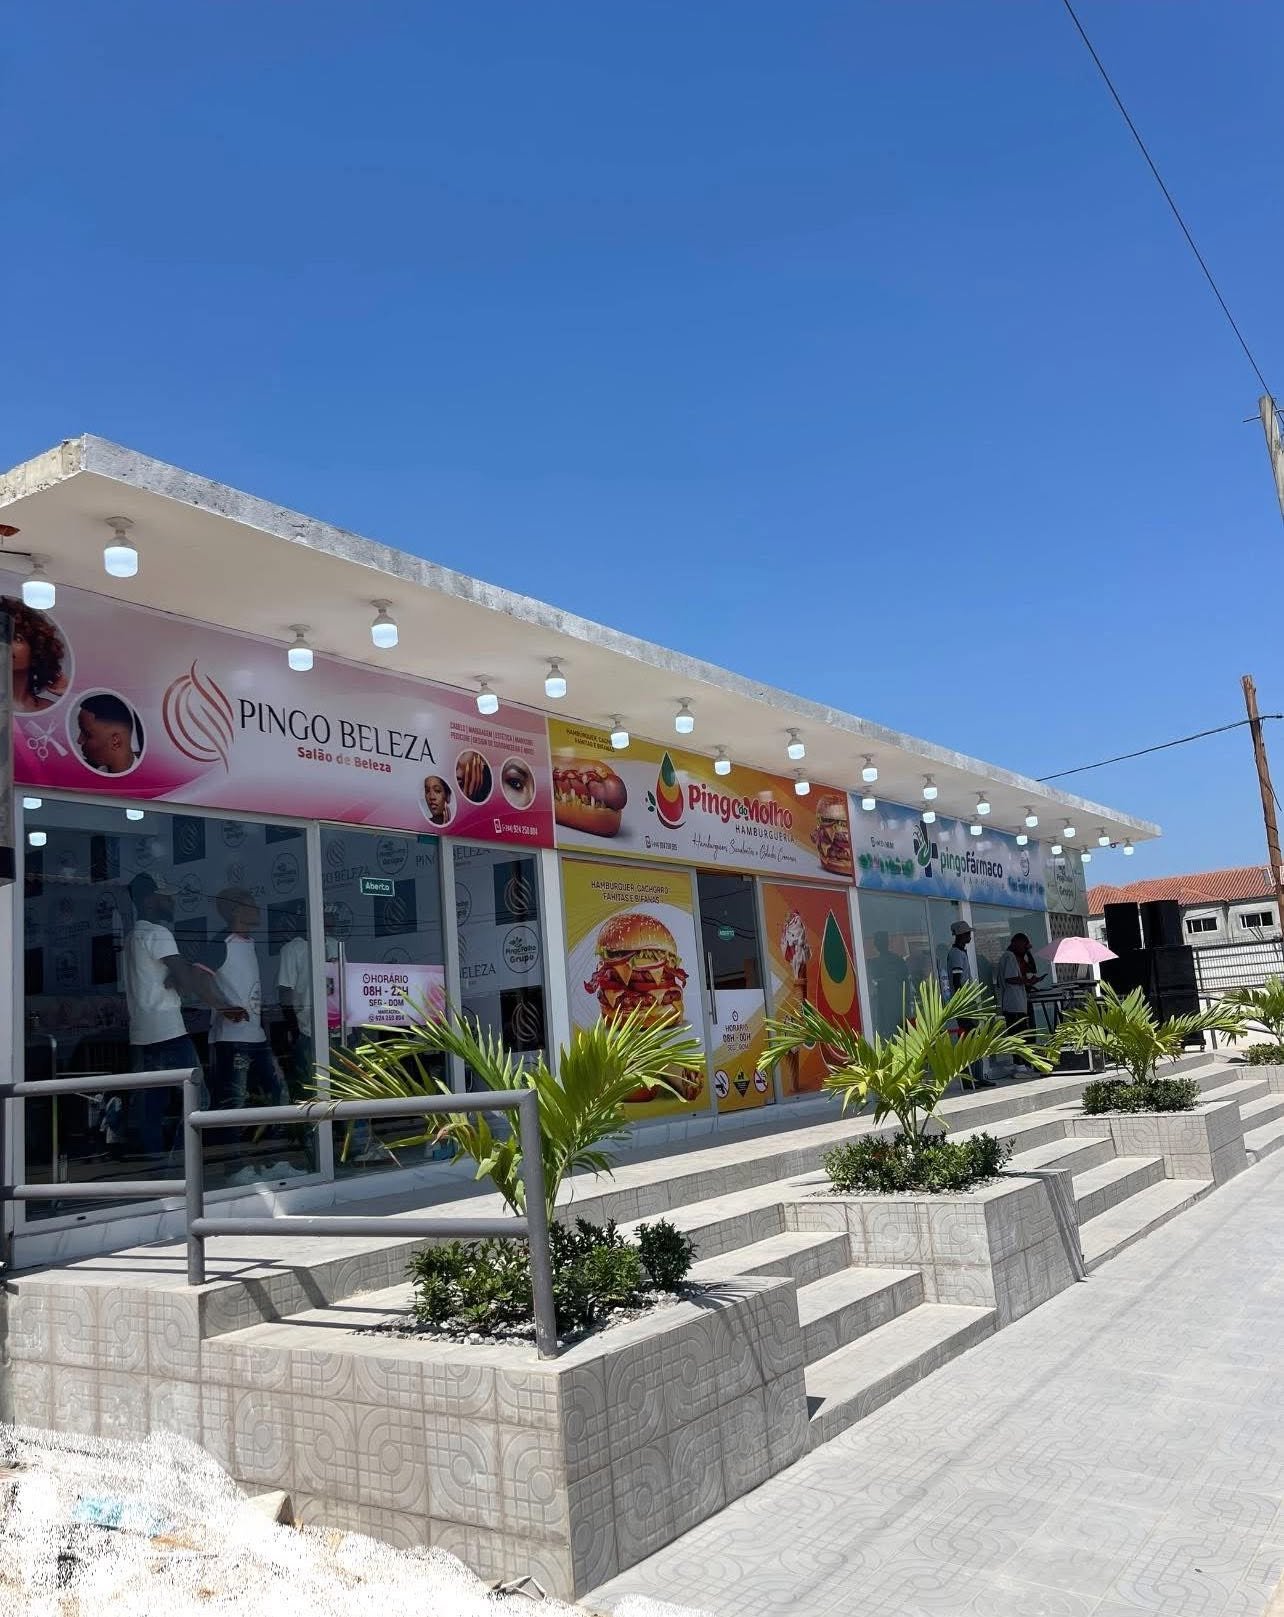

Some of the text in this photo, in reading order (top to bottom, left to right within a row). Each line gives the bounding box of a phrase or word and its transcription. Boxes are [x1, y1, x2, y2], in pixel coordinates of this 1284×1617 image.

[238, 698, 436, 764] PINGO BELEZA
[298, 746, 392, 773] Salão de Beleza
[688, 784, 740, 824] Pingo
[744, 796, 792, 829] Molho
[736, 825, 794, 842] HAMBURGUERIA
[940, 846, 1003, 878] pingofármaco
[366, 880, 390, 891] Aberto
[510, 954, 534, 964] Grupo
[371, 973, 408, 984] HORÁRIO
[460, 963, 496, 979] ELEZA
[364, 986, 382, 996] 08H
[391, 986, 408, 996] 22H
